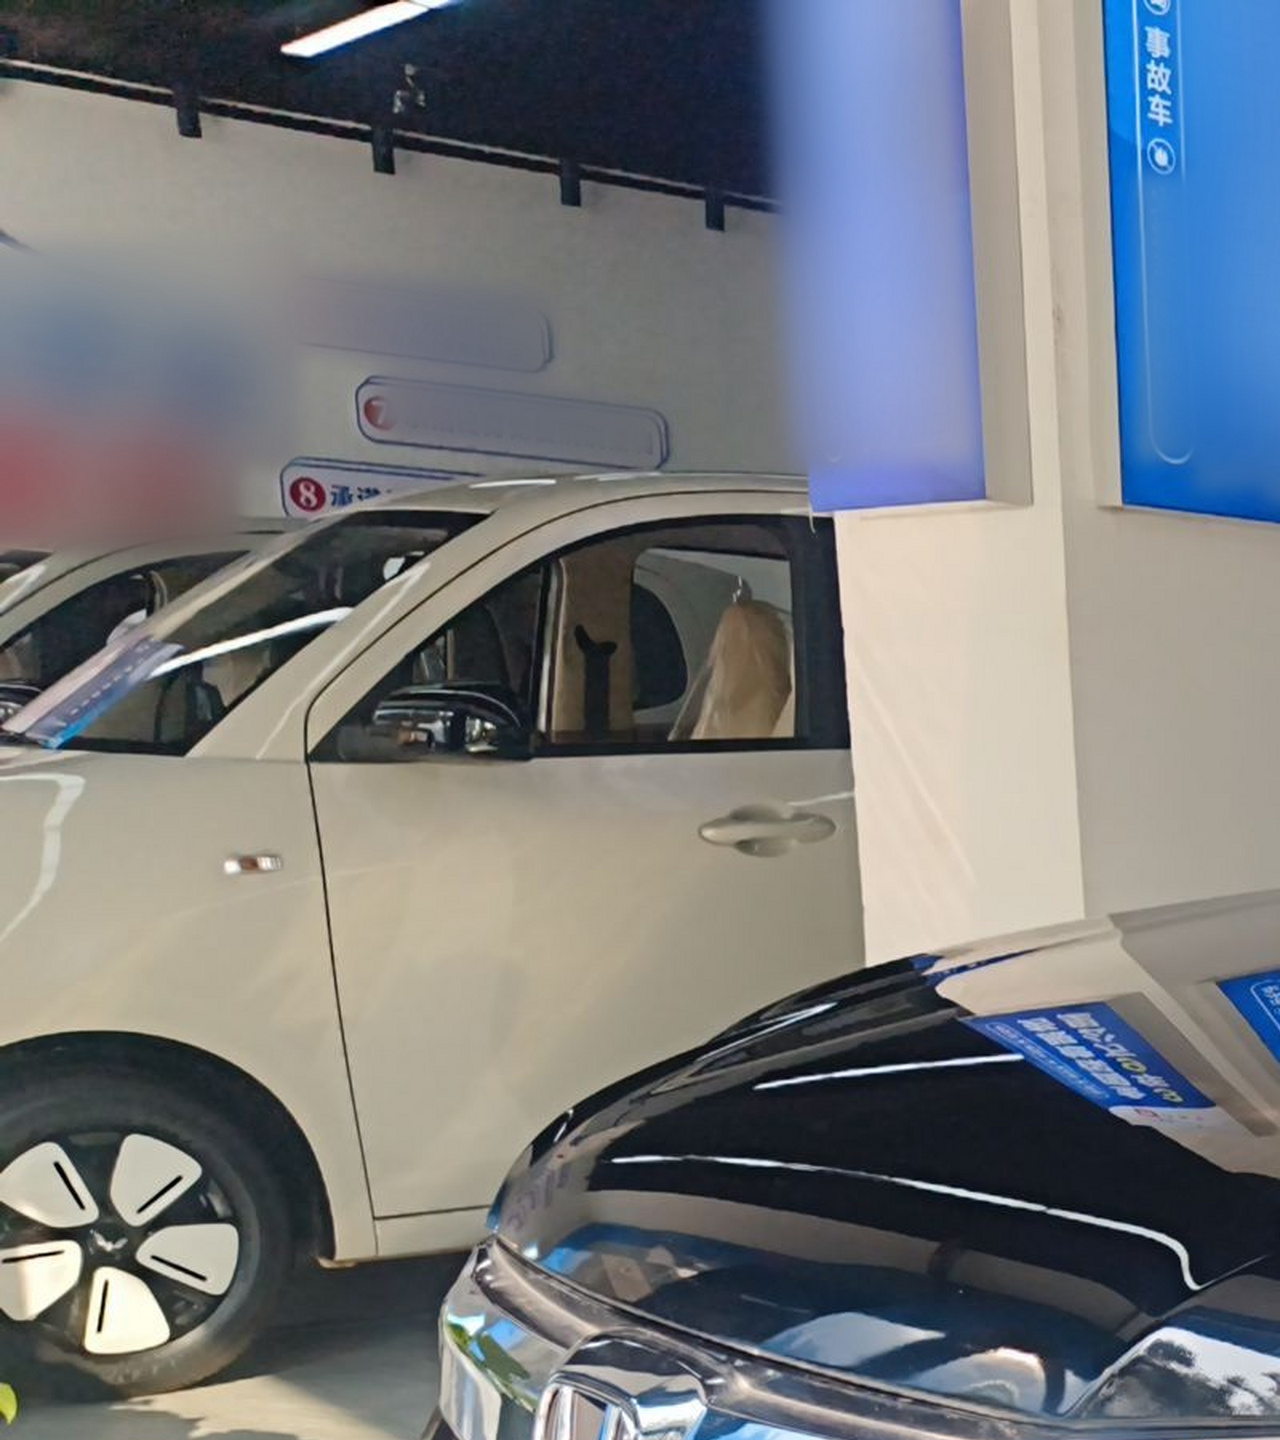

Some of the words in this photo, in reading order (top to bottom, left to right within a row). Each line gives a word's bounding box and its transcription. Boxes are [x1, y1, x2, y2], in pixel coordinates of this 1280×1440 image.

[1144, 25, 1173, 127] 事故车
[299, 480, 318, 508] 8
